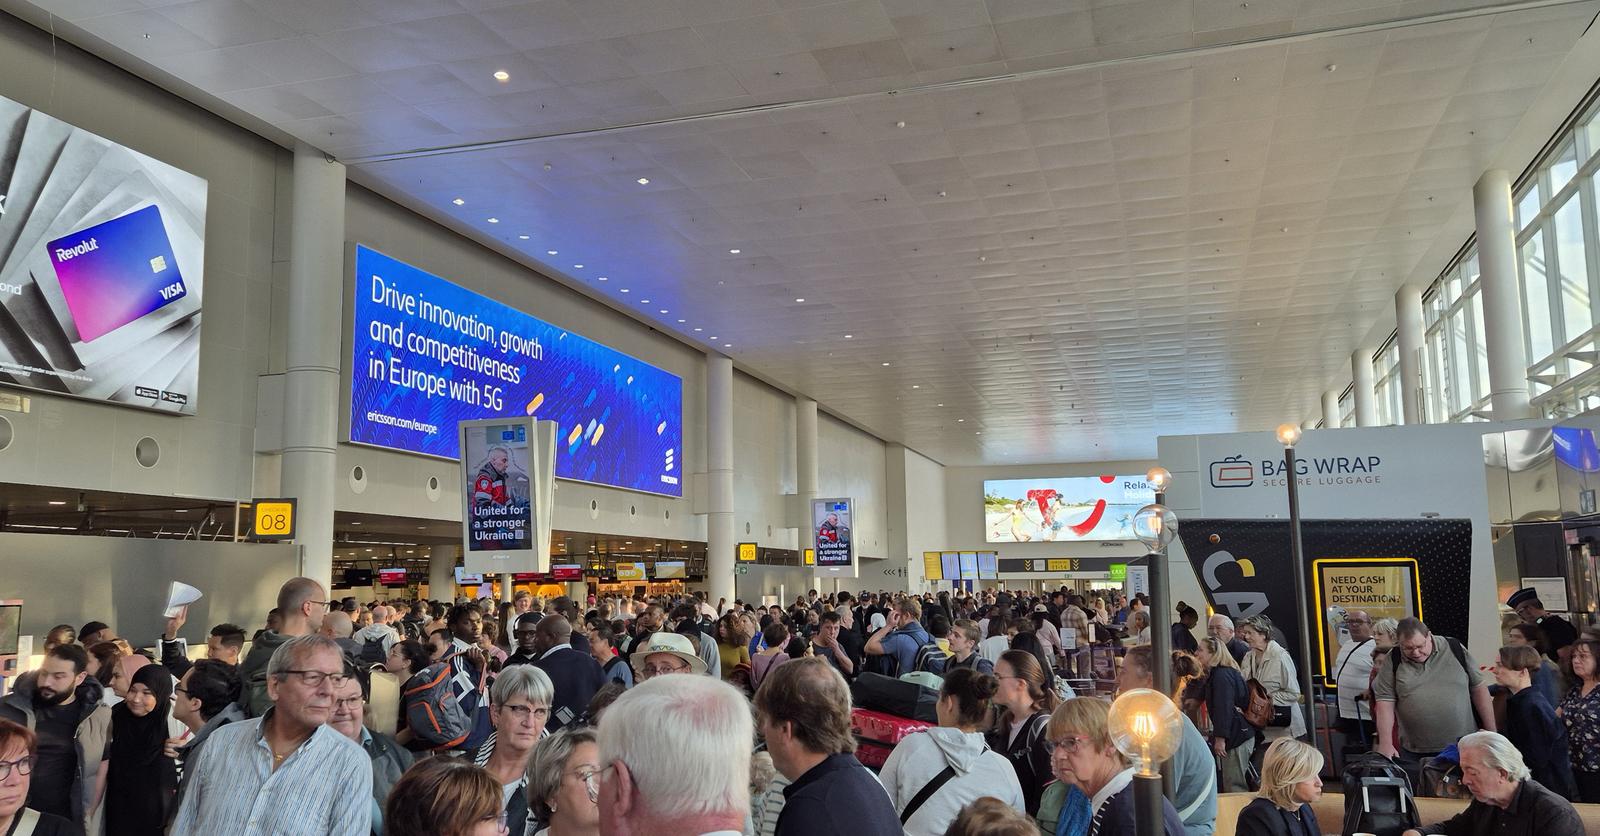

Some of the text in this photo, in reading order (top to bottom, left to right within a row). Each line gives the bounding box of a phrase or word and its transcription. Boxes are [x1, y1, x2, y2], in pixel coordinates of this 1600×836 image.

[56, 238, 99, 262] Revolut
[159, 282, 184, 300] VISA
[372, 275, 543, 361] Drive innovation, growth
[370, 320, 520, 384] and competitiveness
[369, 351, 503, 411] in Europe with 5G
[367, 410, 437, 434] ericsson.com/europe
[1262, 456, 1381, 476] BAG WRAP
[1124, 480, 1150, 490] Rela
[1264, 475, 1381, 487] SECRE LUGGAGE
[474, 505, 524, 516] United for
[262, 514, 286, 530] 08
[474, 519, 526, 529] a stronger
[475, 530, 514, 540] Ukraine
[742, 550, 754, 559] 09
[1331, 576, 1386, 584] NEED CASH
[1346, 585, 1373, 593] YOUR
[1333, 594, 1401, 603] DESTINATION?
